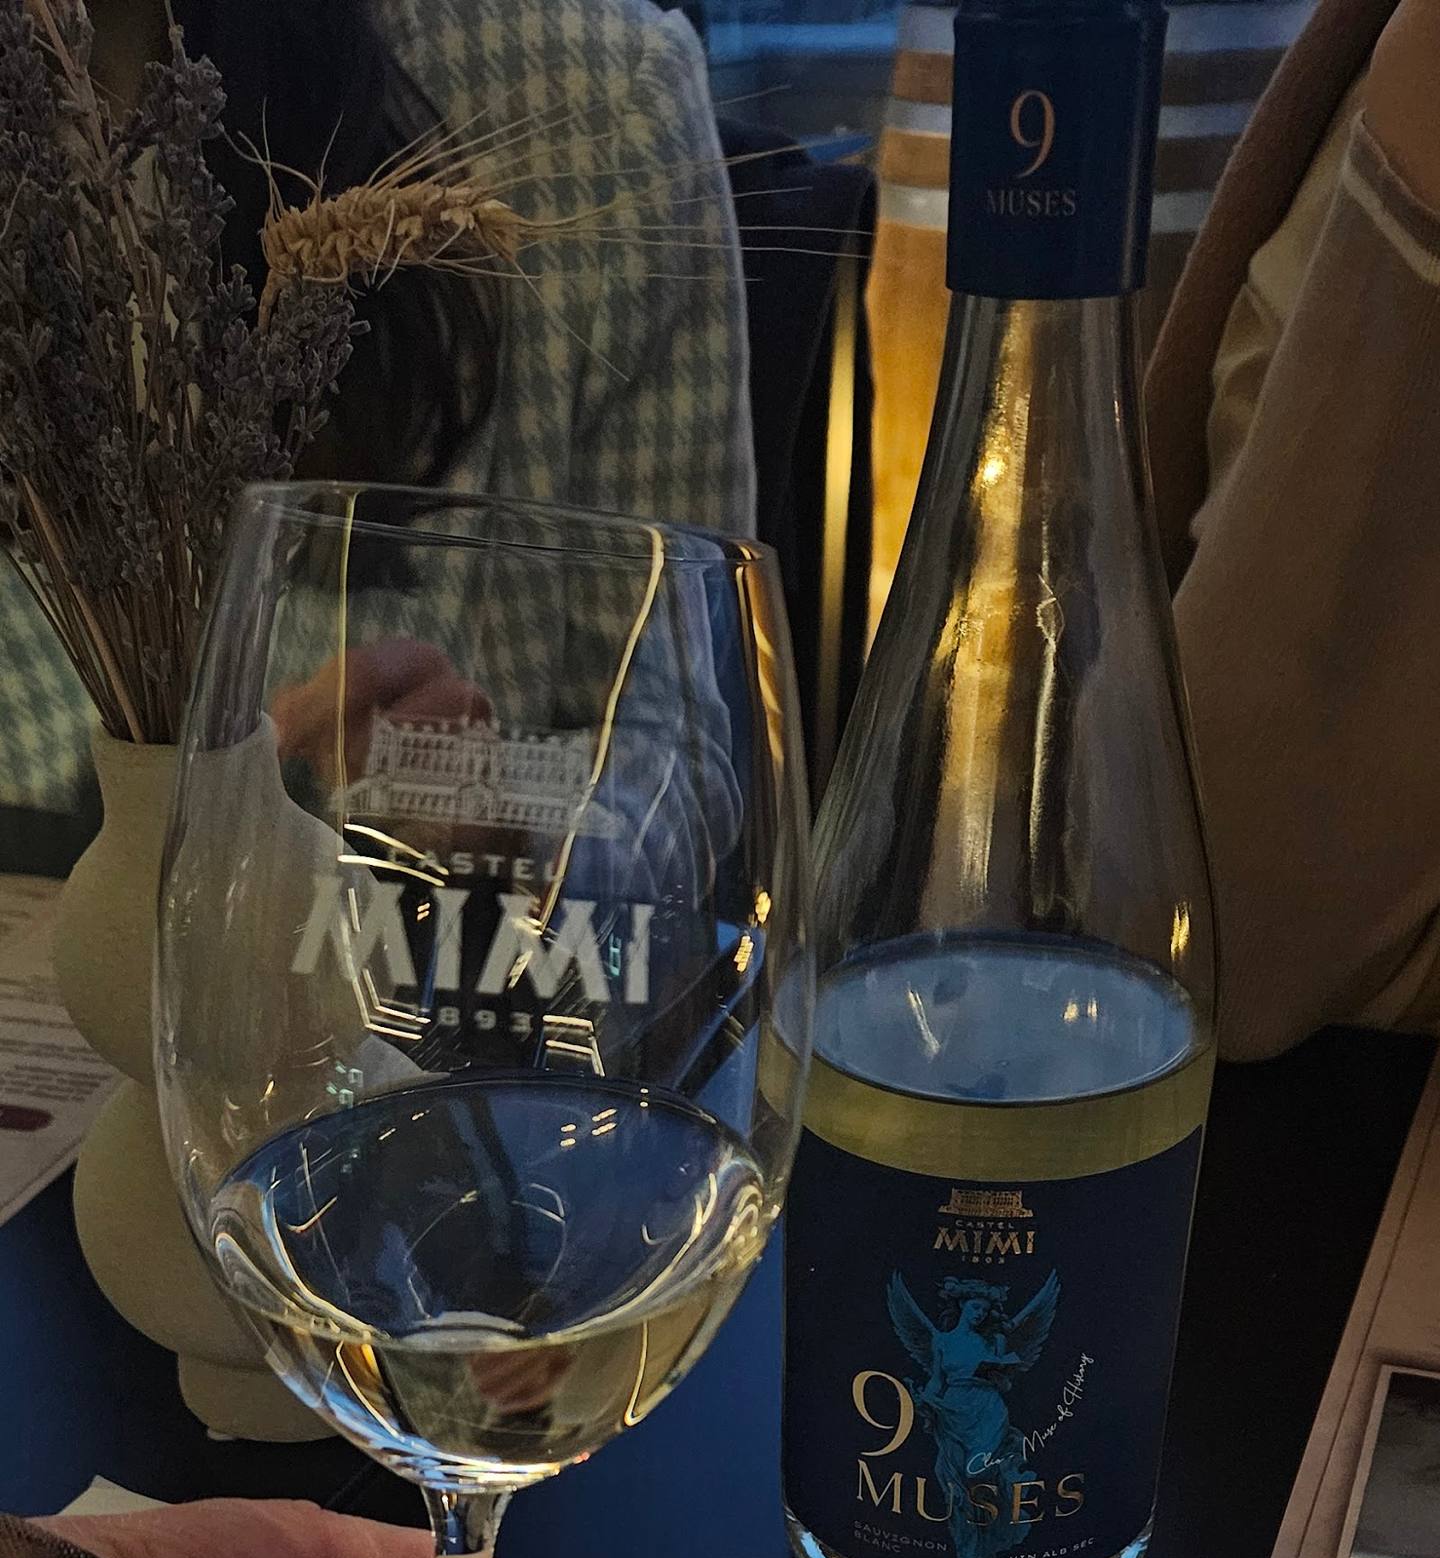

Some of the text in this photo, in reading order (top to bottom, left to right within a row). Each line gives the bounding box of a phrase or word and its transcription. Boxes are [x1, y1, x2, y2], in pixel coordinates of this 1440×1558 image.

[1009, 88, 1056, 180] 9
[985, 189, 1077, 217] MUSES
[291, 874, 655, 1005] MIMI
[933, 1226, 1036, 1256] MIMI
[955, 1219, 1015, 1230] CASTEL
[852, 1369, 915, 1457] 9
[1022, 1421, 1057, 1462] Muse
[1057, 1404, 1074, 1422] of
[855, 1458, 1086, 1527] MUSES
[853, 1519, 948, 1553] SAUVIGNON
[853, 1529, 902, 1553] BLANC
[1073, 1536, 1096, 1552] SEC
